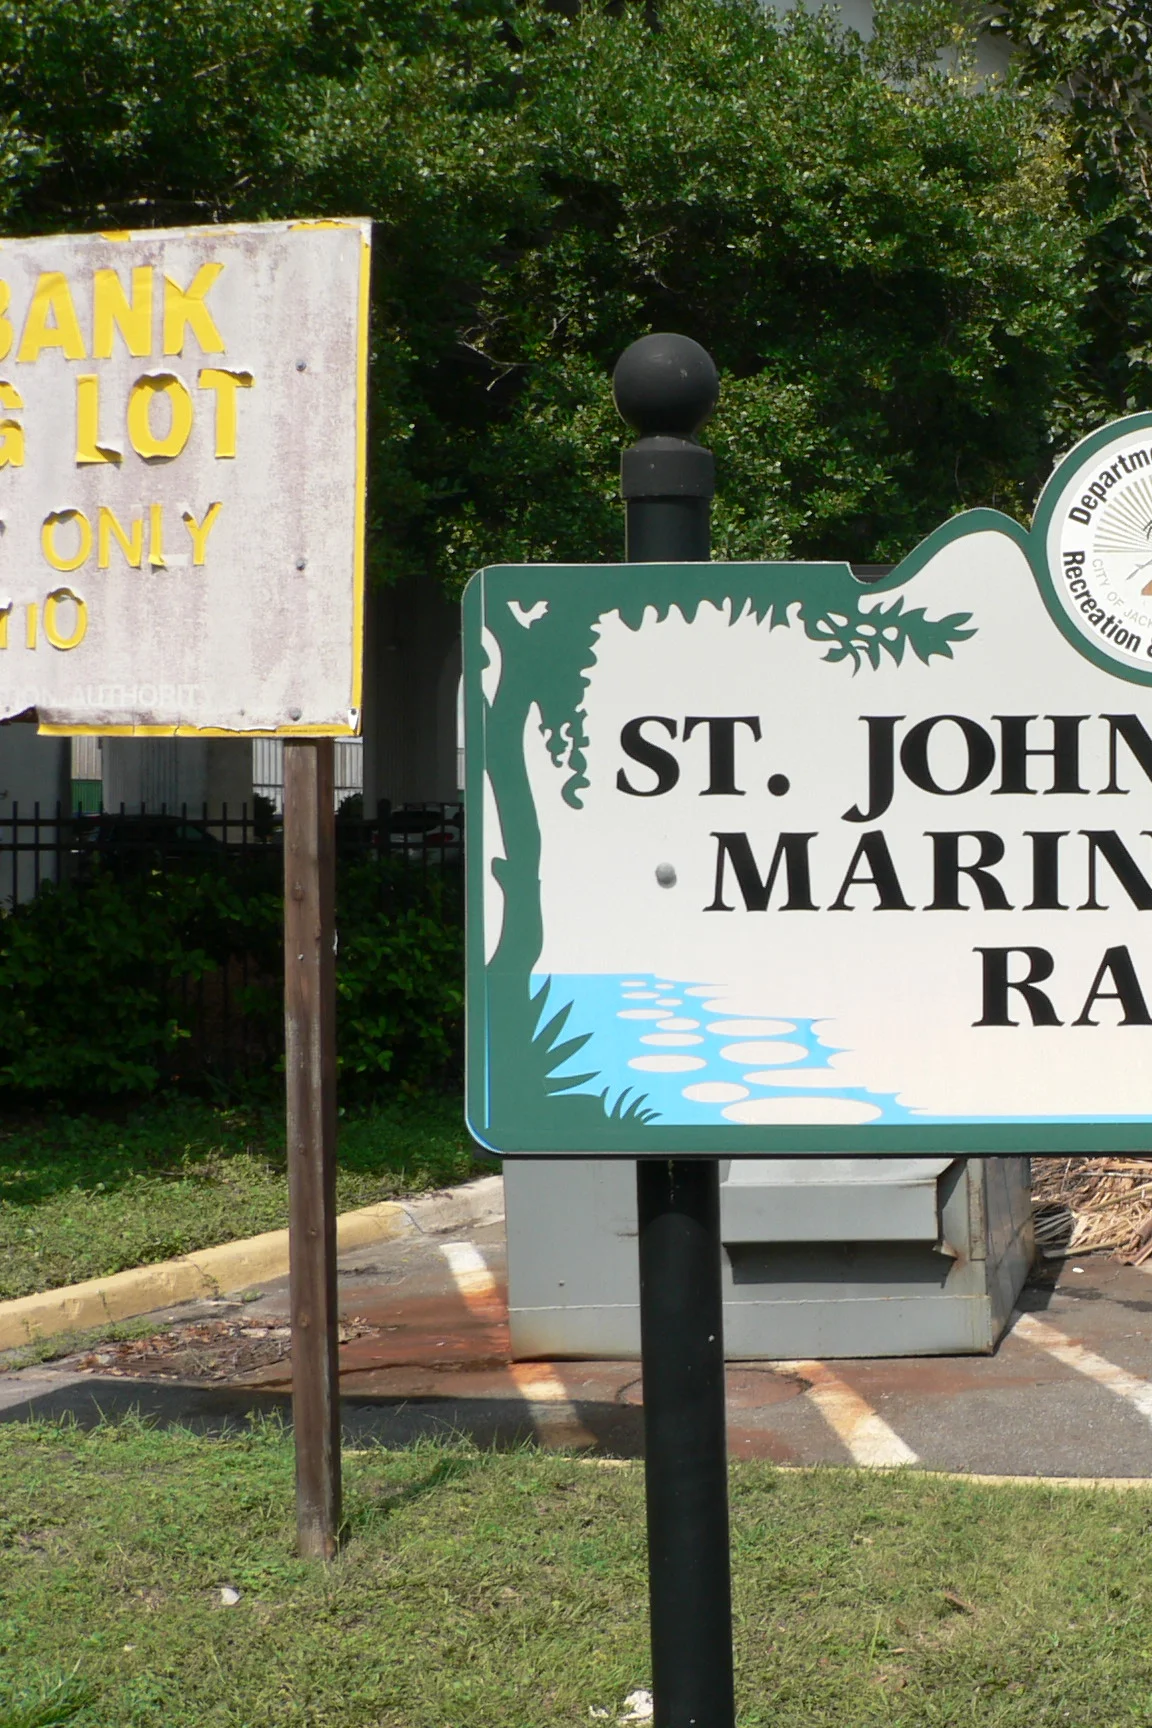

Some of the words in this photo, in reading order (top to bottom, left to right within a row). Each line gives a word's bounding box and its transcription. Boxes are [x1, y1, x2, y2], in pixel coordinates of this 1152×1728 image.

[0, 262, 225, 363] ANK
[76, 368, 255, 465] LOT
[41, 502, 223, 571] ONLY
[1062, 550, 1142, 653] Recreation
[1092, 558, 1110, 588] CITY
[1107, 591, 1124, 608] OF
[615, 715, 791, 797] ST.
